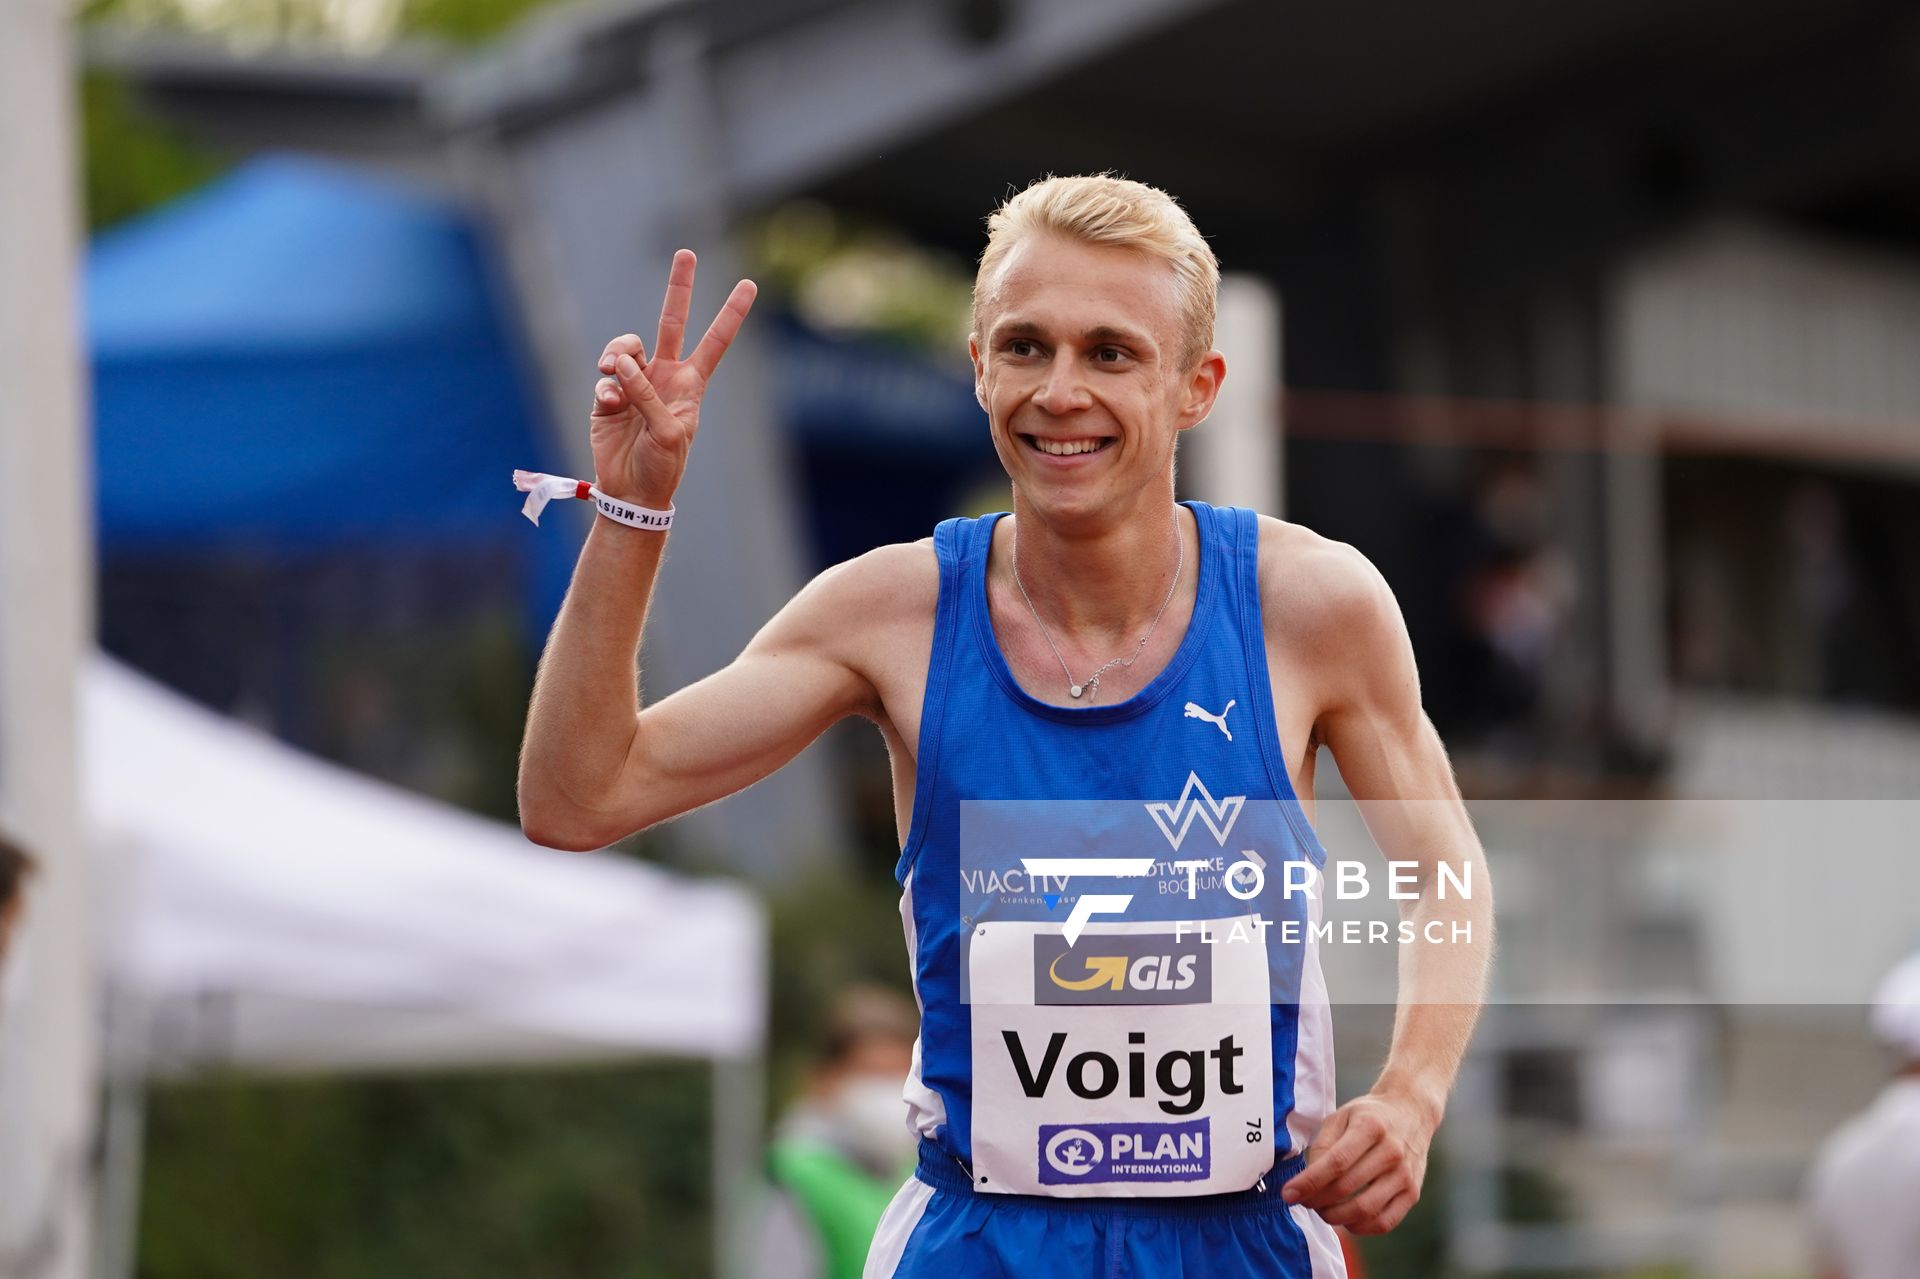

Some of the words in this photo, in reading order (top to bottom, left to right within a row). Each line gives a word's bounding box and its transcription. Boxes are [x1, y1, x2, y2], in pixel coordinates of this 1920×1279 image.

[960, 868, 1070, 894] VIACTIV
[1128, 954, 1198, 991] GLS
[1001, 1030, 1244, 1116] Voigt
[1246, 1117, 1262, 1144] 78
[1110, 1132, 1203, 1160] PLAN
[1111, 1163, 1203, 1175] INTERNATIONAL
